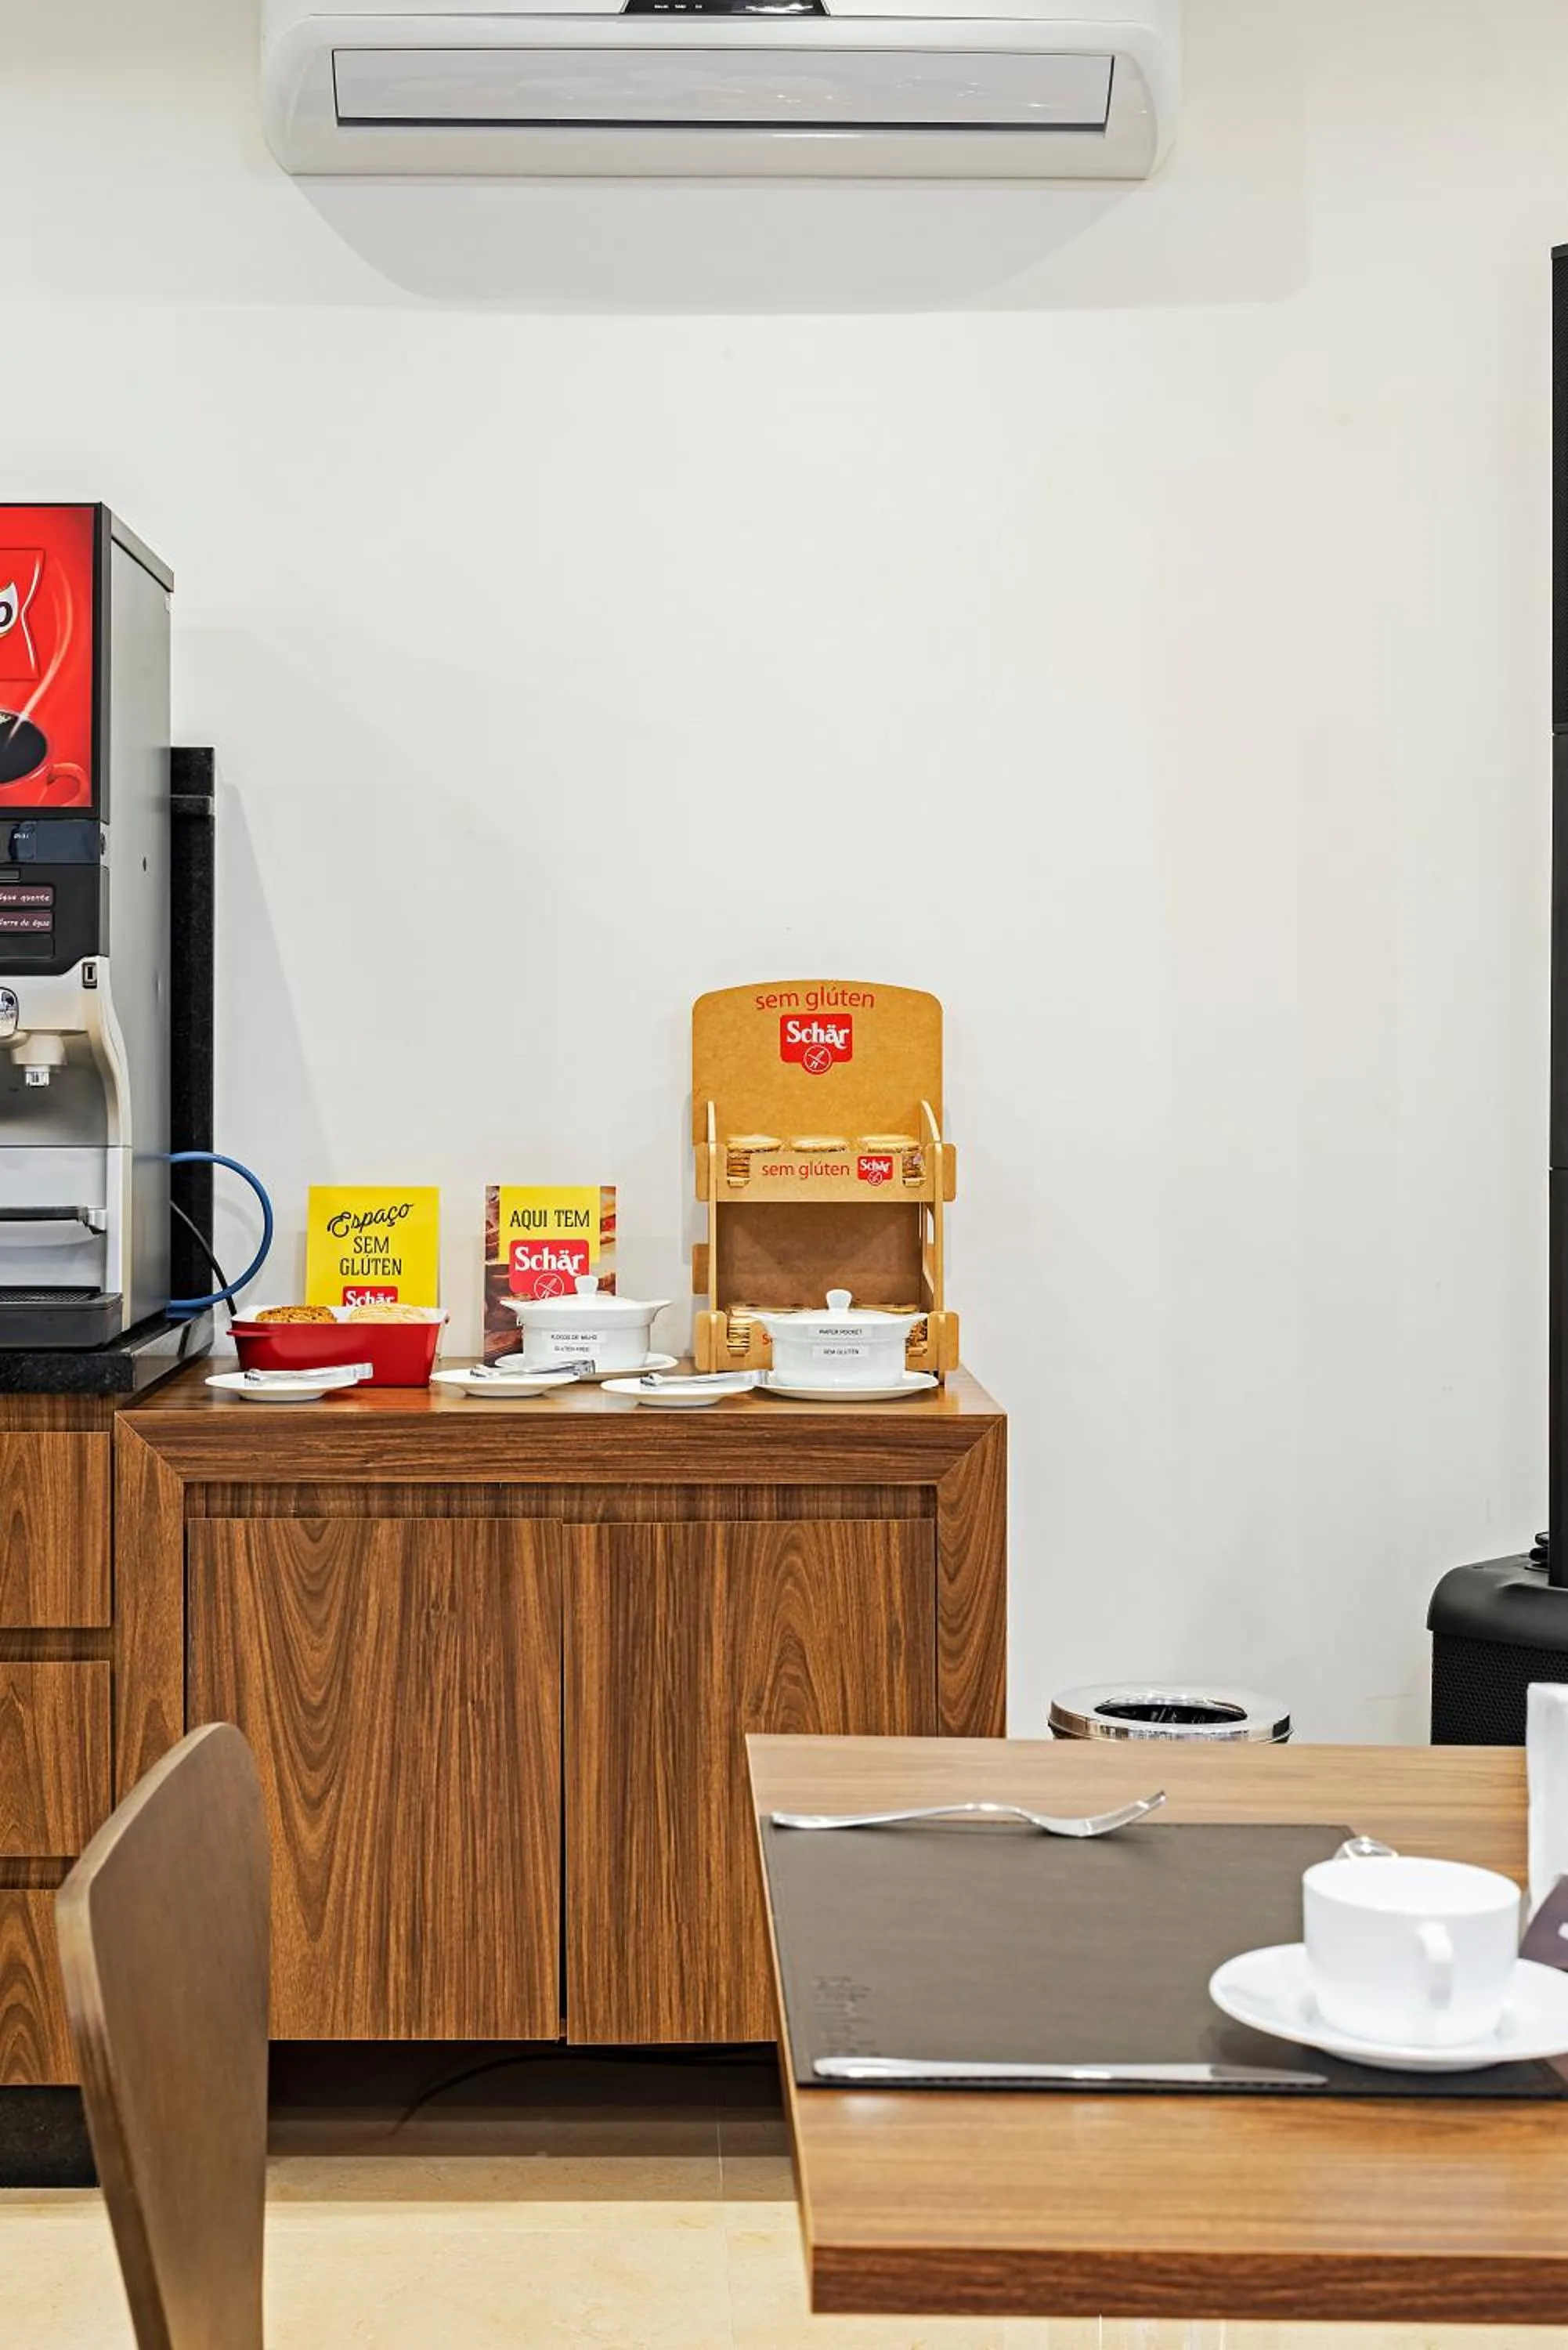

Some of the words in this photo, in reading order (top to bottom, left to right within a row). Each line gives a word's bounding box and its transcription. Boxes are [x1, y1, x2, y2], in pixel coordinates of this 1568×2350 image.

[756, 992, 799, 1010] sem
[806, 986, 875, 1011] glúten
[786, 1021, 850, 1050] Schär
[762, 1164, 794, 1176] sem
[799, 1160, 850, 1180] glúten
[860, 1159, 891, 1172] Schär
[327, 1203, 414, 1238] Espaço
[510, 1209, 547, 1231] AQUI
[555, 1209, 589, 1227] TEM
[353, 1236, 388, 1253] SEM
[339, 1254, 401, 1276] GLÚTEN
[515, 1246, 585, 1278] Schär
